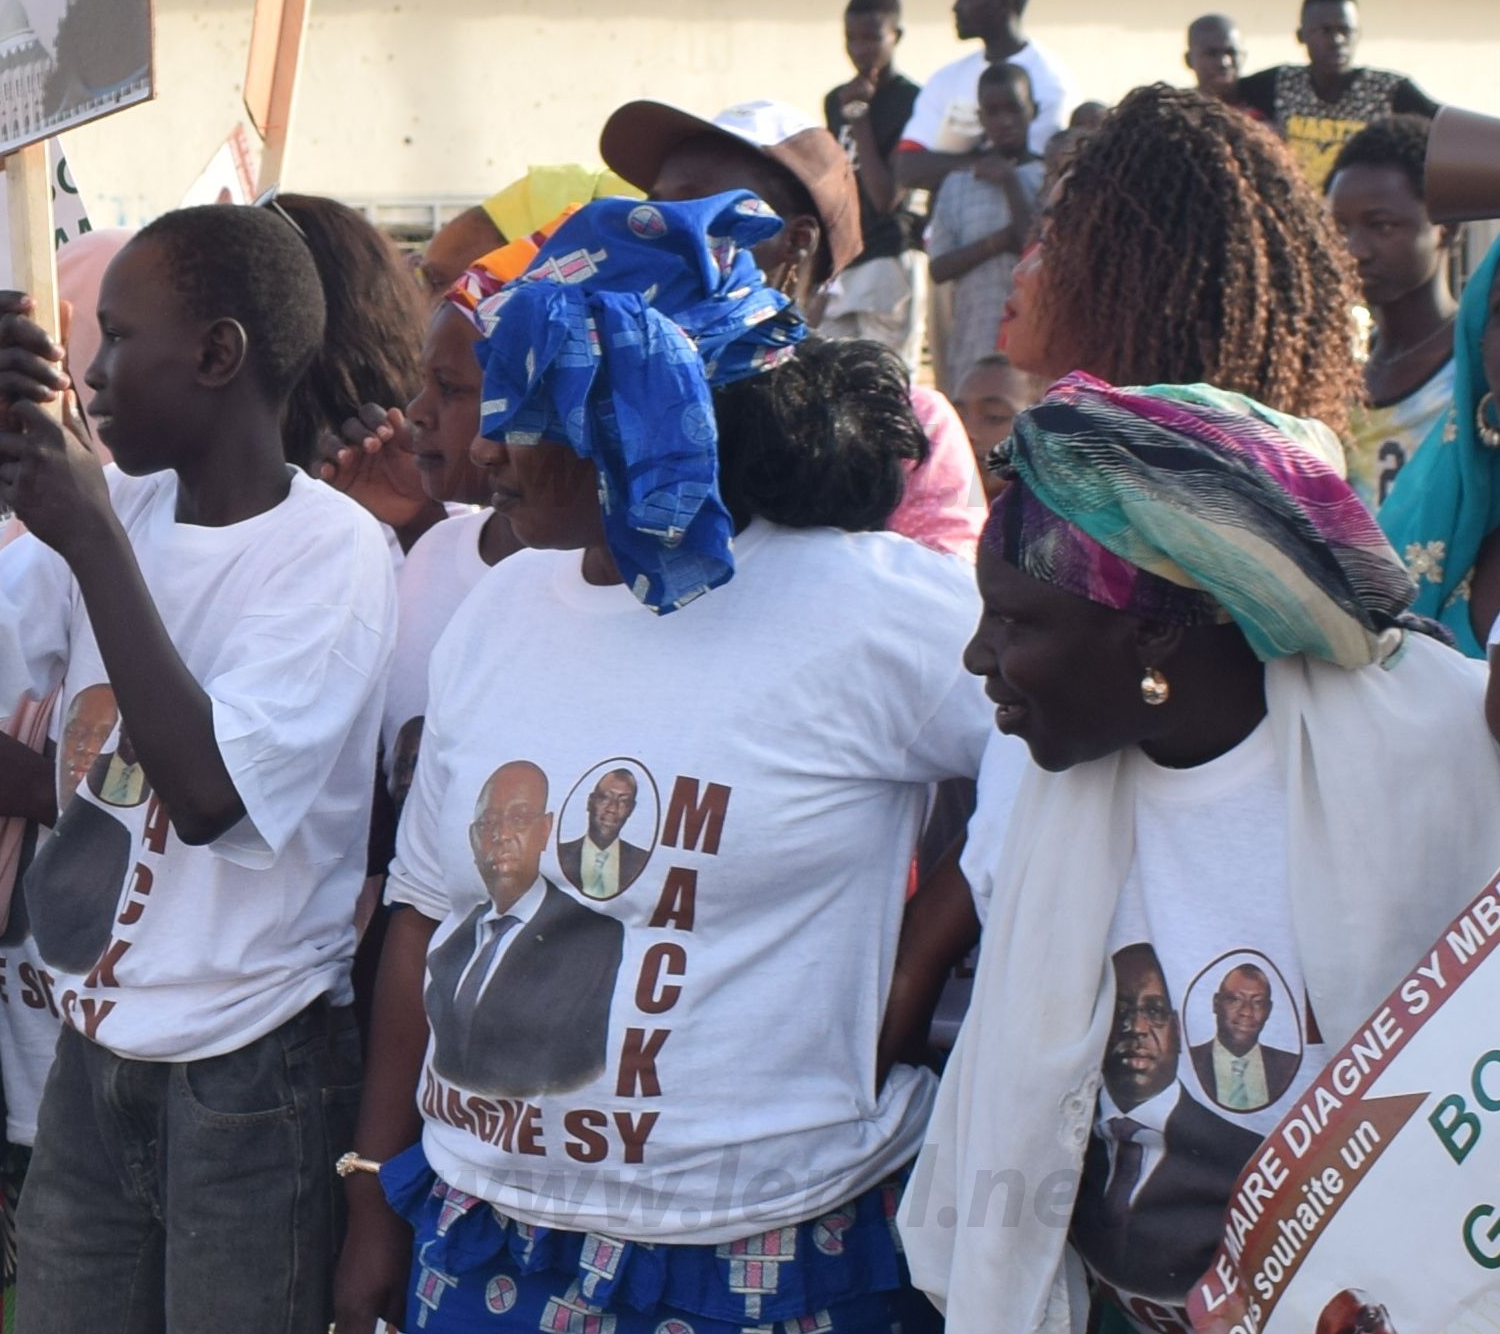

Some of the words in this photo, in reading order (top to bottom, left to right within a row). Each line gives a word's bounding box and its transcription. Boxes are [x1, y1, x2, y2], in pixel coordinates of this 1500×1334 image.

[421, 1063, 547, 1158] DIAGNE
[564, 1109, 661, 1165] SY
[1201, 1253, 1240, 1313] LE
[1223, 1145, 1290, 1268] MAIRE
[1281, 1006, 1404, 1159] DIAGNE
[1400, 951, 1447, 1015] SY
[1254, 1167, 1345, 1301] souhaite
[1340, 1119, 1381, 1172] un
